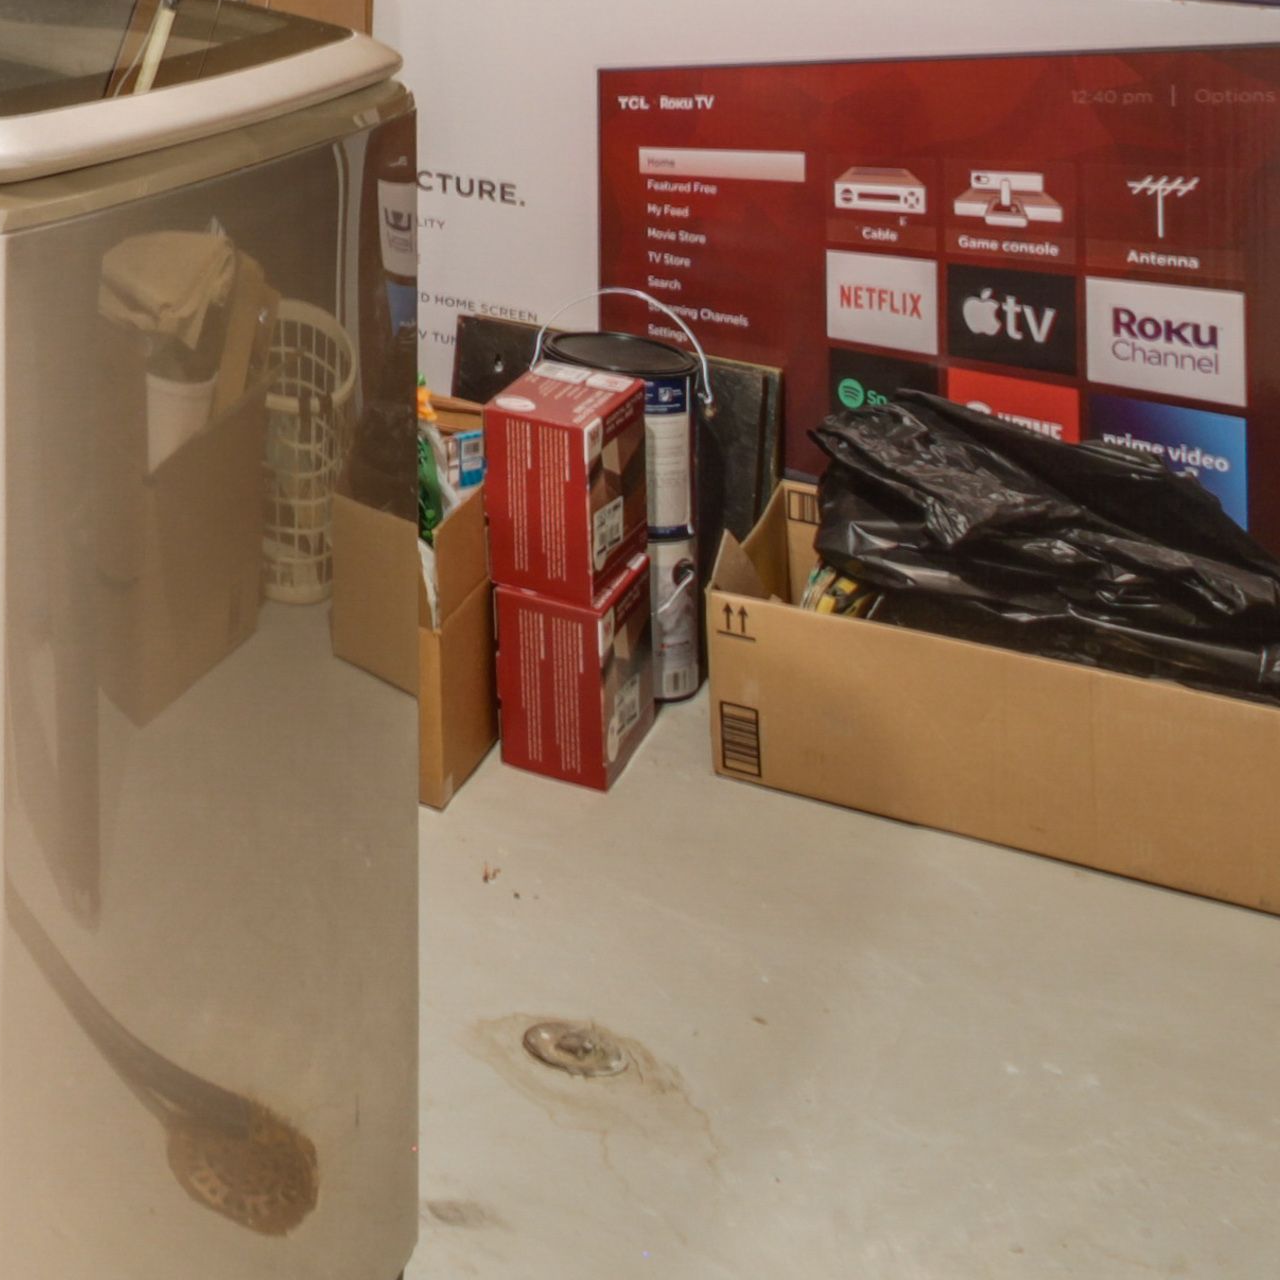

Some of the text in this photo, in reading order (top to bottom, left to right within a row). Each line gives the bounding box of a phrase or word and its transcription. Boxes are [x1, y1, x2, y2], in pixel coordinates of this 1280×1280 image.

[617, 95, 650, 111] TCL
[694, 94, 715, 110] TV
[1071, 89, 1153, 106] 12:40 pm
[1194, 87, 1276, 105] Options
[647, 157, 676, 169] Home
[647, 179, 718, 195] Featured Free
[647, 202, 689, 217] My Feed
[647, 226, 707, 244] Movie Store
[861, 226, 899, 242] Cable
[957, 234, 1060, 258] Game console
[648, 251, 691, 268] TV Store
[1126, 248, 1201, 271] Antenna
[647, 275, 681, 291] Search
[435, 295, 476, 312] HOME
[480, 303, 538, 323] SCREEN
[839, 282, 924, 320] NETFLIX
[700, 307, 750, 328] Channels
[647, 323, 689, 342] Settings
[1111, 305, 1219, 349] Roku
[1111, 338, 1221, 376] Channel
[1167, 443, 1230, 473] video
